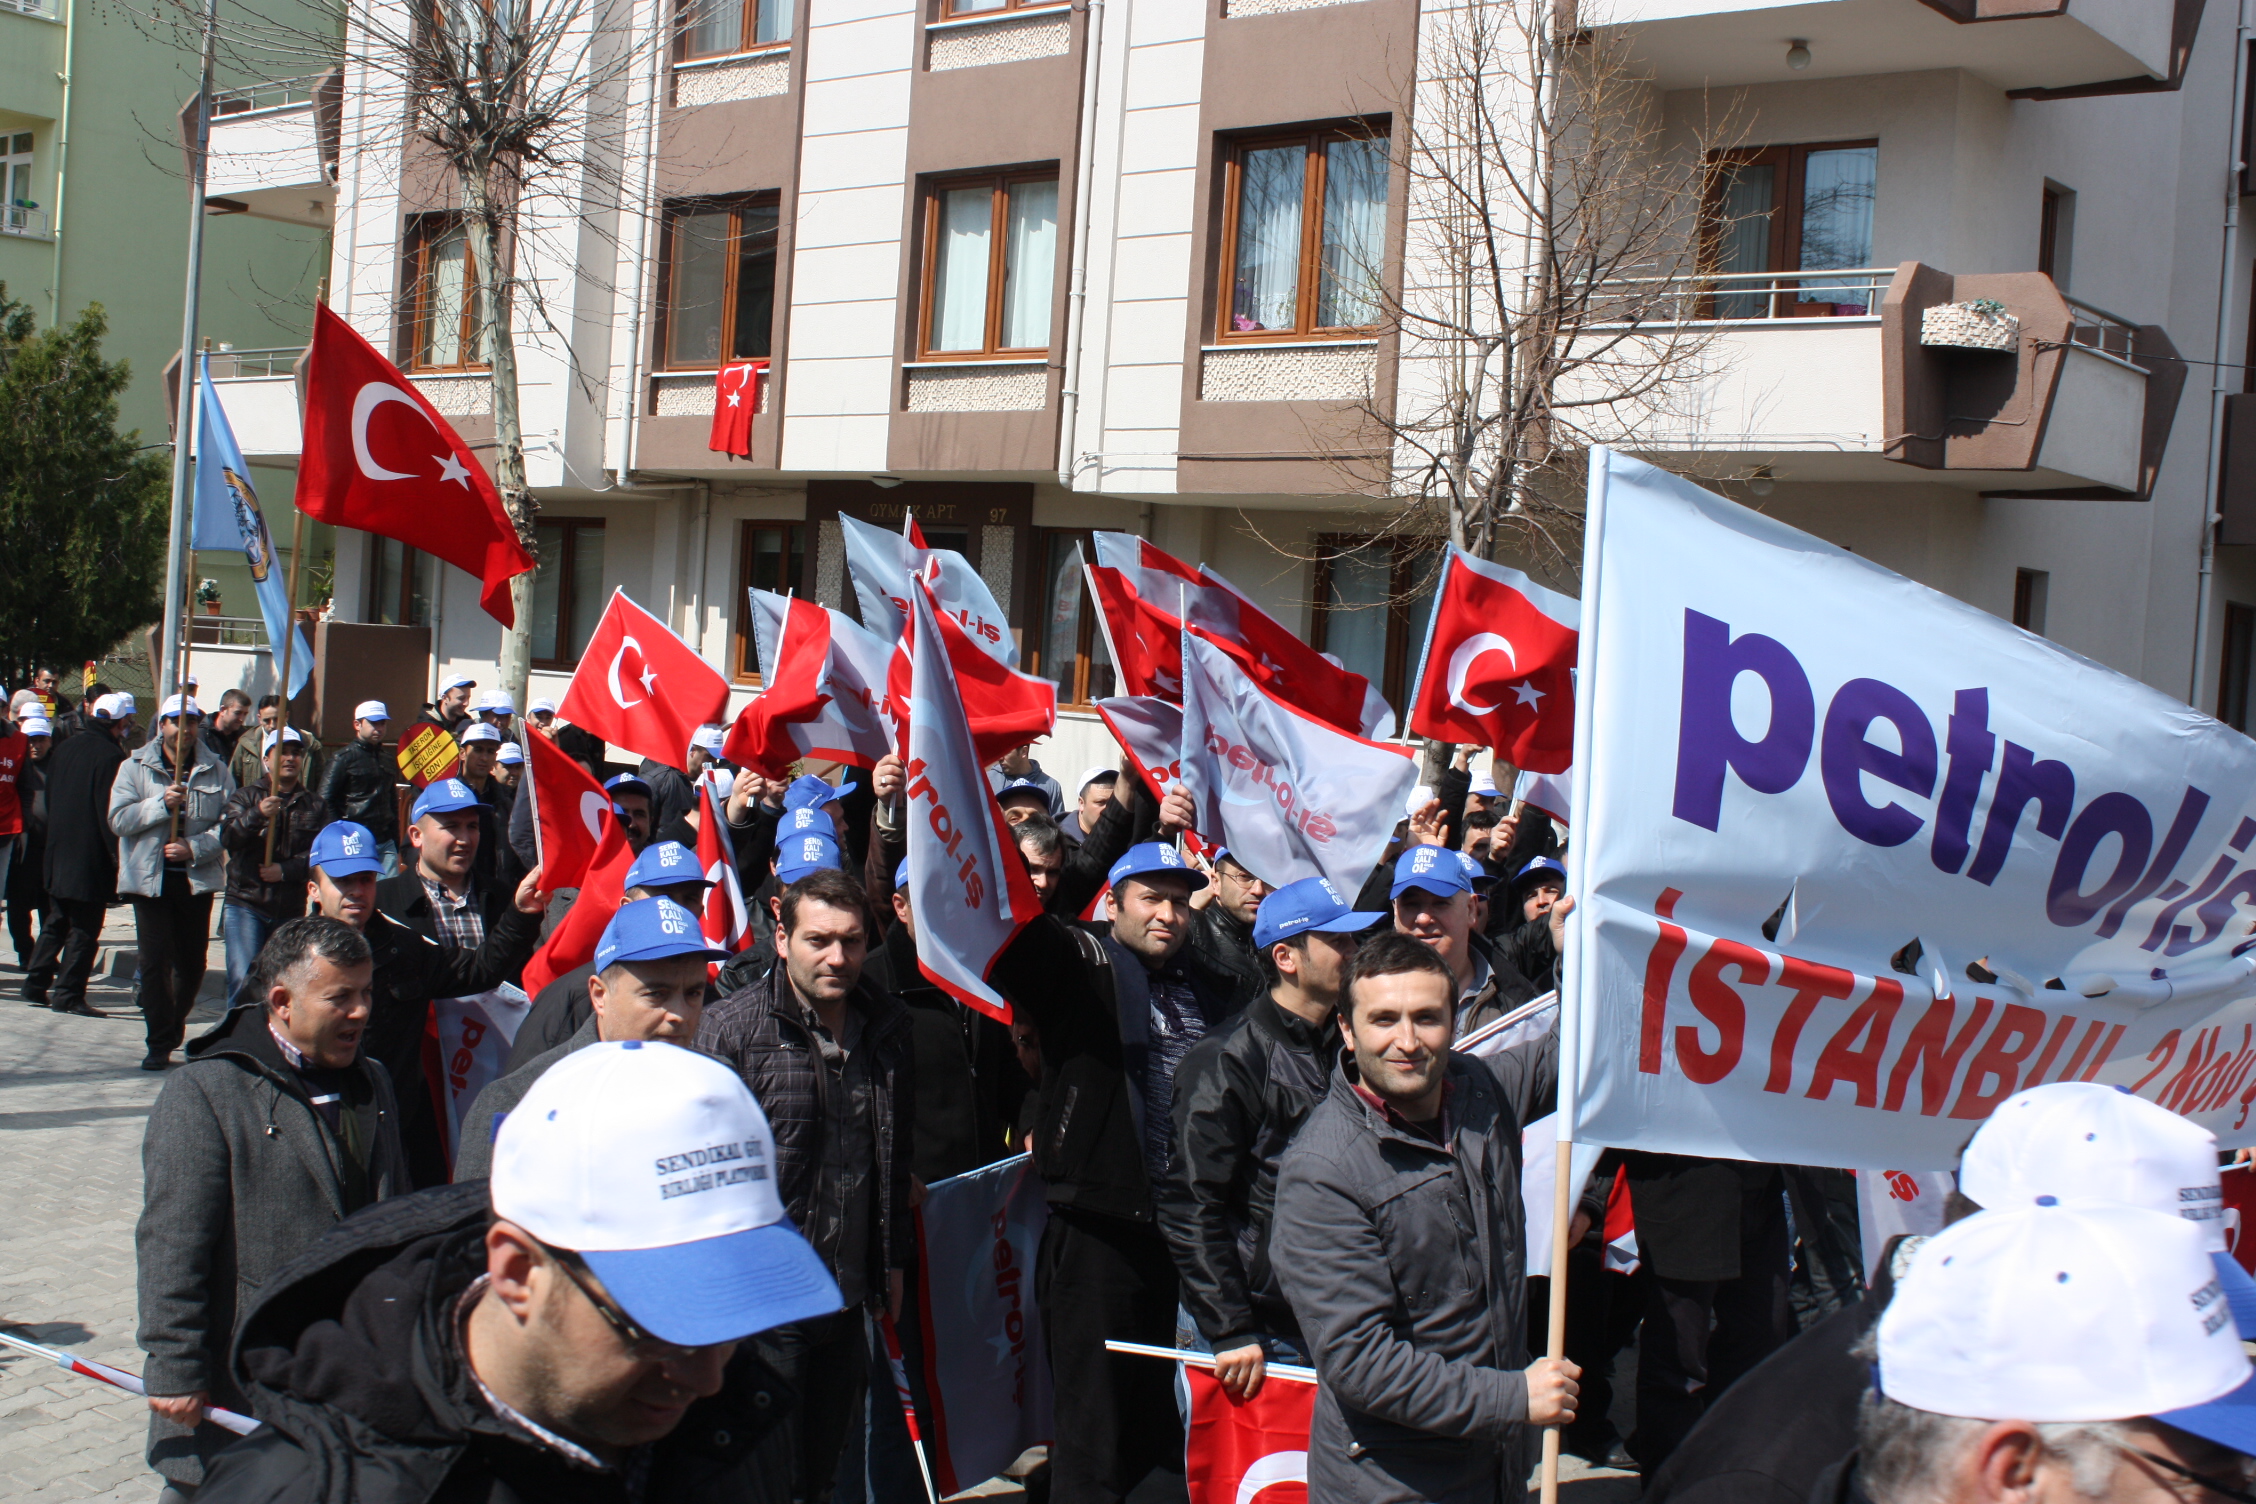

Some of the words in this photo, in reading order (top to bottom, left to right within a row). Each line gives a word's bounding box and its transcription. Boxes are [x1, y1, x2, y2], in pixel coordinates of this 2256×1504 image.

[926, 504, 956, 519] APT
[990, 508, 1008, 523] 97
[407, 730, 433, 755] TAŞERON
[412, 740, 442, 770] İŞÇİLİĞİNE
[425, 758, 443, 778] SON!
[795, 820, 809, 829] OL
[907, 757, 984, 910] trol-iş
[344, 845, 359, 856] OL
[659, 849, 678, 858] KALI
[1415, 847, 1438, 858] SENDİ
[660, 857, 678, 868] OL
[803, 852, 818, 862] OL
[1413, 855, 1431, 864] KALI
[1411, 862, 1427, 874] OL
[659, 909, 683, 921] KALI
[661, 920, 684, 934] OL
[1279, 916, 1309, 930] petrol-iş
